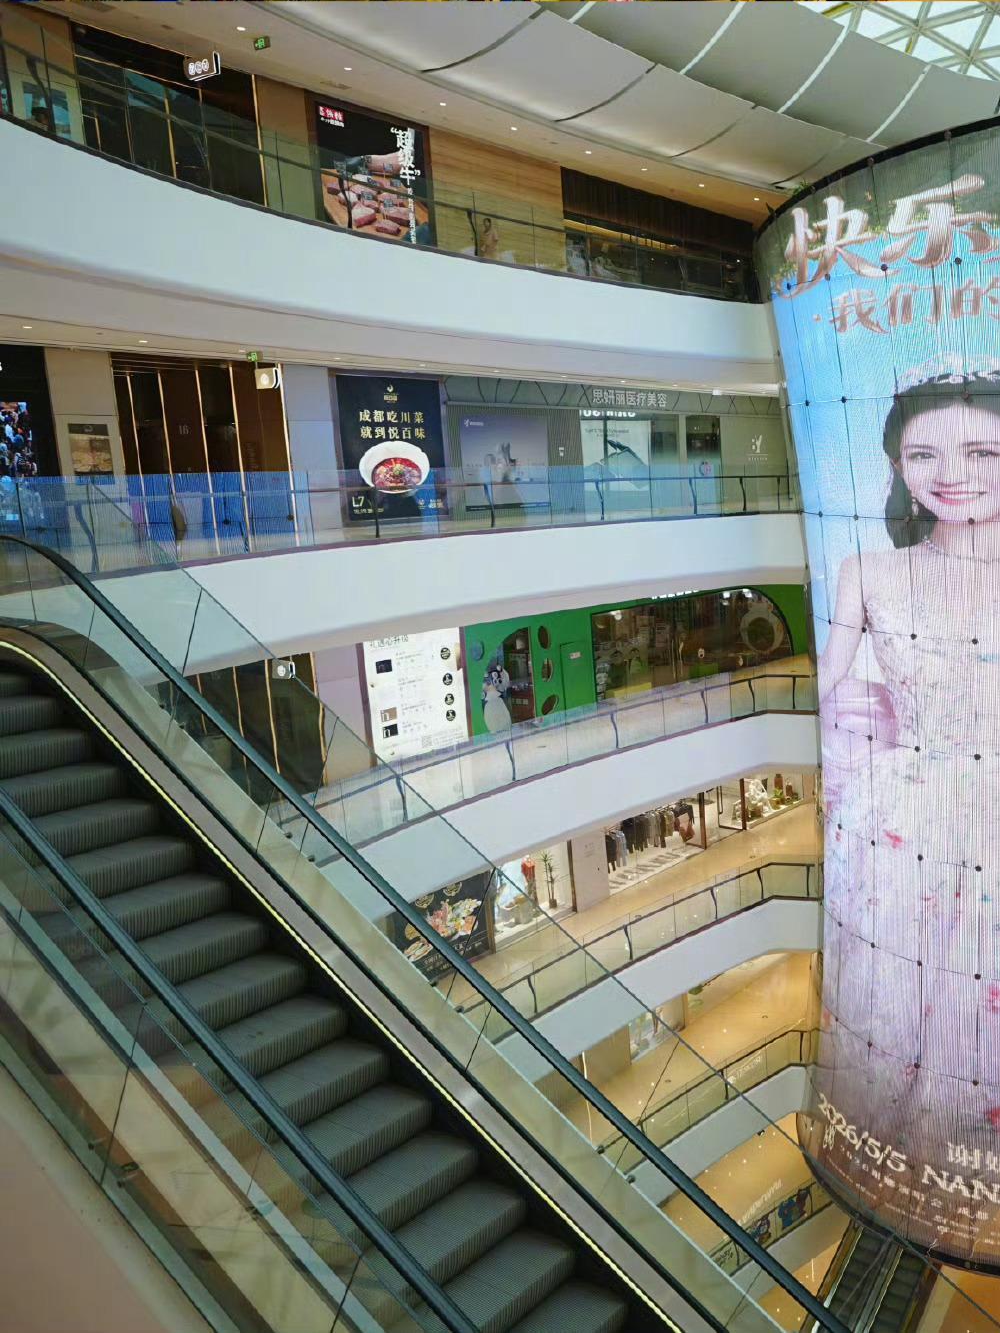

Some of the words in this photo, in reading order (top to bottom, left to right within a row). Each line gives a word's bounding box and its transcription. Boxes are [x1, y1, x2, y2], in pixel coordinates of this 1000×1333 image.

[359, 409, 425, 423] 成都吃川菜
[360, 426, 426, 440] 就到悦百味
[352, 496, 365, 508] L7
[818, 1093, 907, 1172] 2026/5/5
